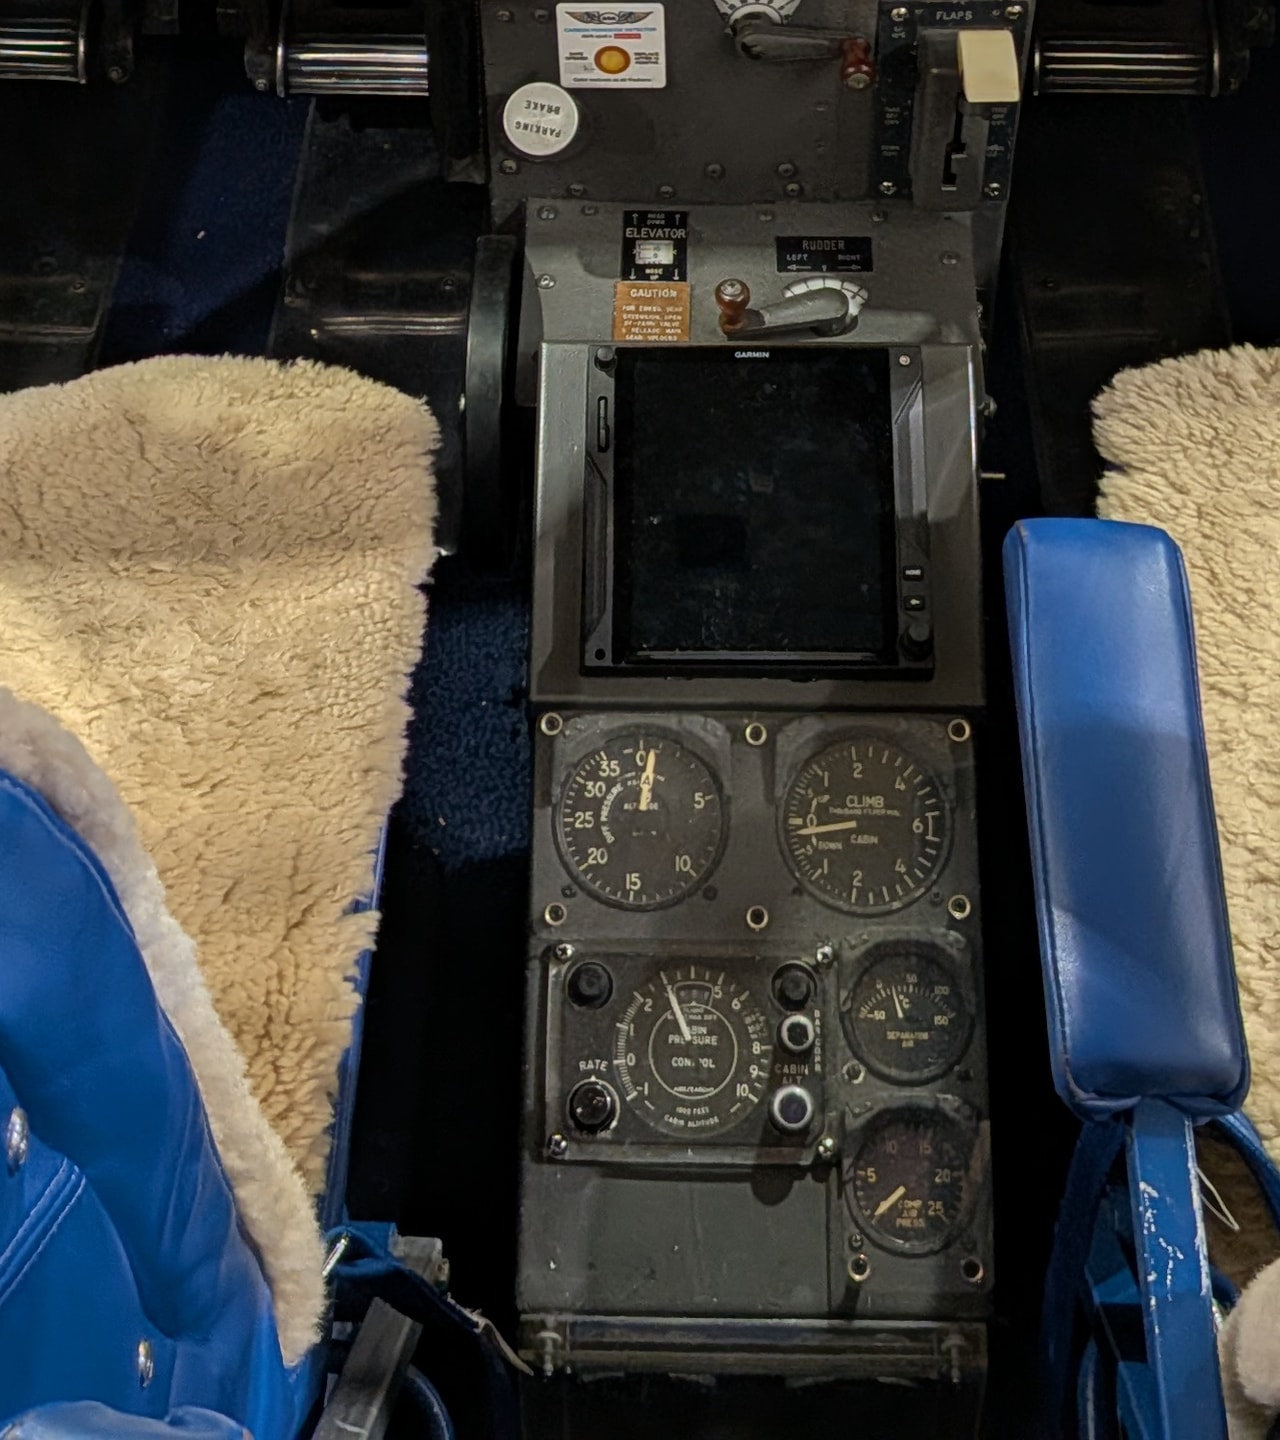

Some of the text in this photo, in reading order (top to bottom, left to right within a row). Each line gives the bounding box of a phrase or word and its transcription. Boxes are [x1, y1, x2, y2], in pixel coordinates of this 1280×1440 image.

[935, 10, 974, 22] FLAPS
[524, 99, 562, 116] BRAKE
[513, 120, 563, 138] PARKING
[625, 227, 687, 239] ELEVATOR
[801, 239, 846, 251] RUDDER
[785, 254, 809, 262] LEFT
[629, 288, 678, 298] CAUTION
[734, 350, 770, 360] GARMIN
[598, 760, 620, 777] 35
[853, 762, 864, 779] 2
[583, 780, 606, 798] 30
[894, 775, 906, 792] 4
[599, 781, 625, 822] PRESSURE
[693, 791, 706, 809] 5
[845, 794, 885, 809] CLIMB
[574, 811, 595, 829] 25
[912, 817, 925, 834] 6
[817, 840, 843, 851] DOWN
[849, 833, 879, 845] CABIN
[587, 847, 608, 865] 20
[674, 855, 691, 872] 10
[894, 858, 907, 874] 4
[625, 872, 642, 891] 15
[852, 870, 863, 887] 2
[713, 985, 723, 999] 5
[643, 998, 654, 1013] 2
[731, 996, 742, 1010] 6
[933, 1016, 949, 1026] 150
[751, 1041, 761, 1055] 8
[578, 1059, 609, 1072] RATE
[626, 1052, 636, 1067] 0
[748, 1064, 759, 1079] 9
[774, 1063, 810, 1076] CABIN
[735, 1082, 750, 1097] 10
[692, 1106, 710, 1115] FEET
[663, 1113, 720, 1129] CABIN ALTITUDE
[885, 1140, 898, 1154] 10
[919, 1140, 933, 1155] 15
[866, 1167, 877, 1183] 5
[934, 1168, 952, 1184] 20
[897, 1199, 924, 1209] COMP
[927, 1200, 945, 1216] 25
[895, 1217, 926, 1229] PRESS
